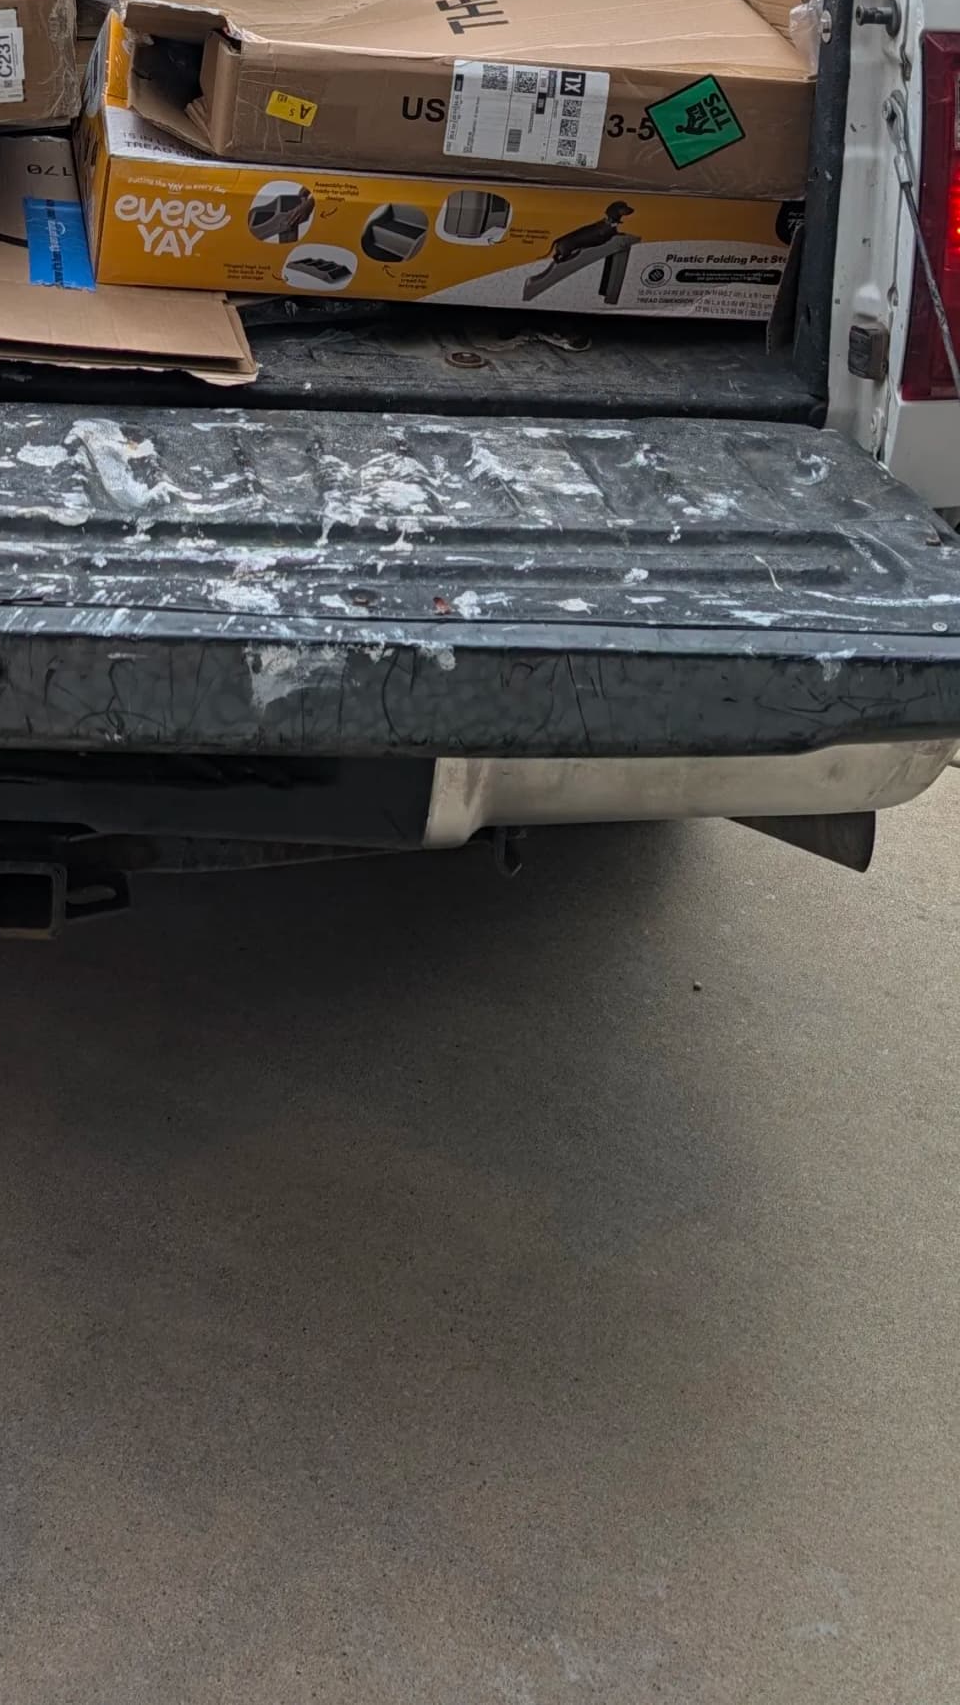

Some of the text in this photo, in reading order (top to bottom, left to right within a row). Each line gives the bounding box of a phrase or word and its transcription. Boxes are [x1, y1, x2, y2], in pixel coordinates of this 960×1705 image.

[563, 74, 583, 94] XL
[300, 103, 312, 120] A
[402, 96, 446, 123] US
[703, 92, 733, 131] TPS
[606, 114, 656, 141] 3-5
[125, 141, 172, 154] TREAD
[167, 182, 184, 191] YAY
[136, 224, 205, 258] YAY
[665, 253, 705, 264] Plastic
[706, 254, 748, 265] Folding
[749, 254, 768, 264] Pet
